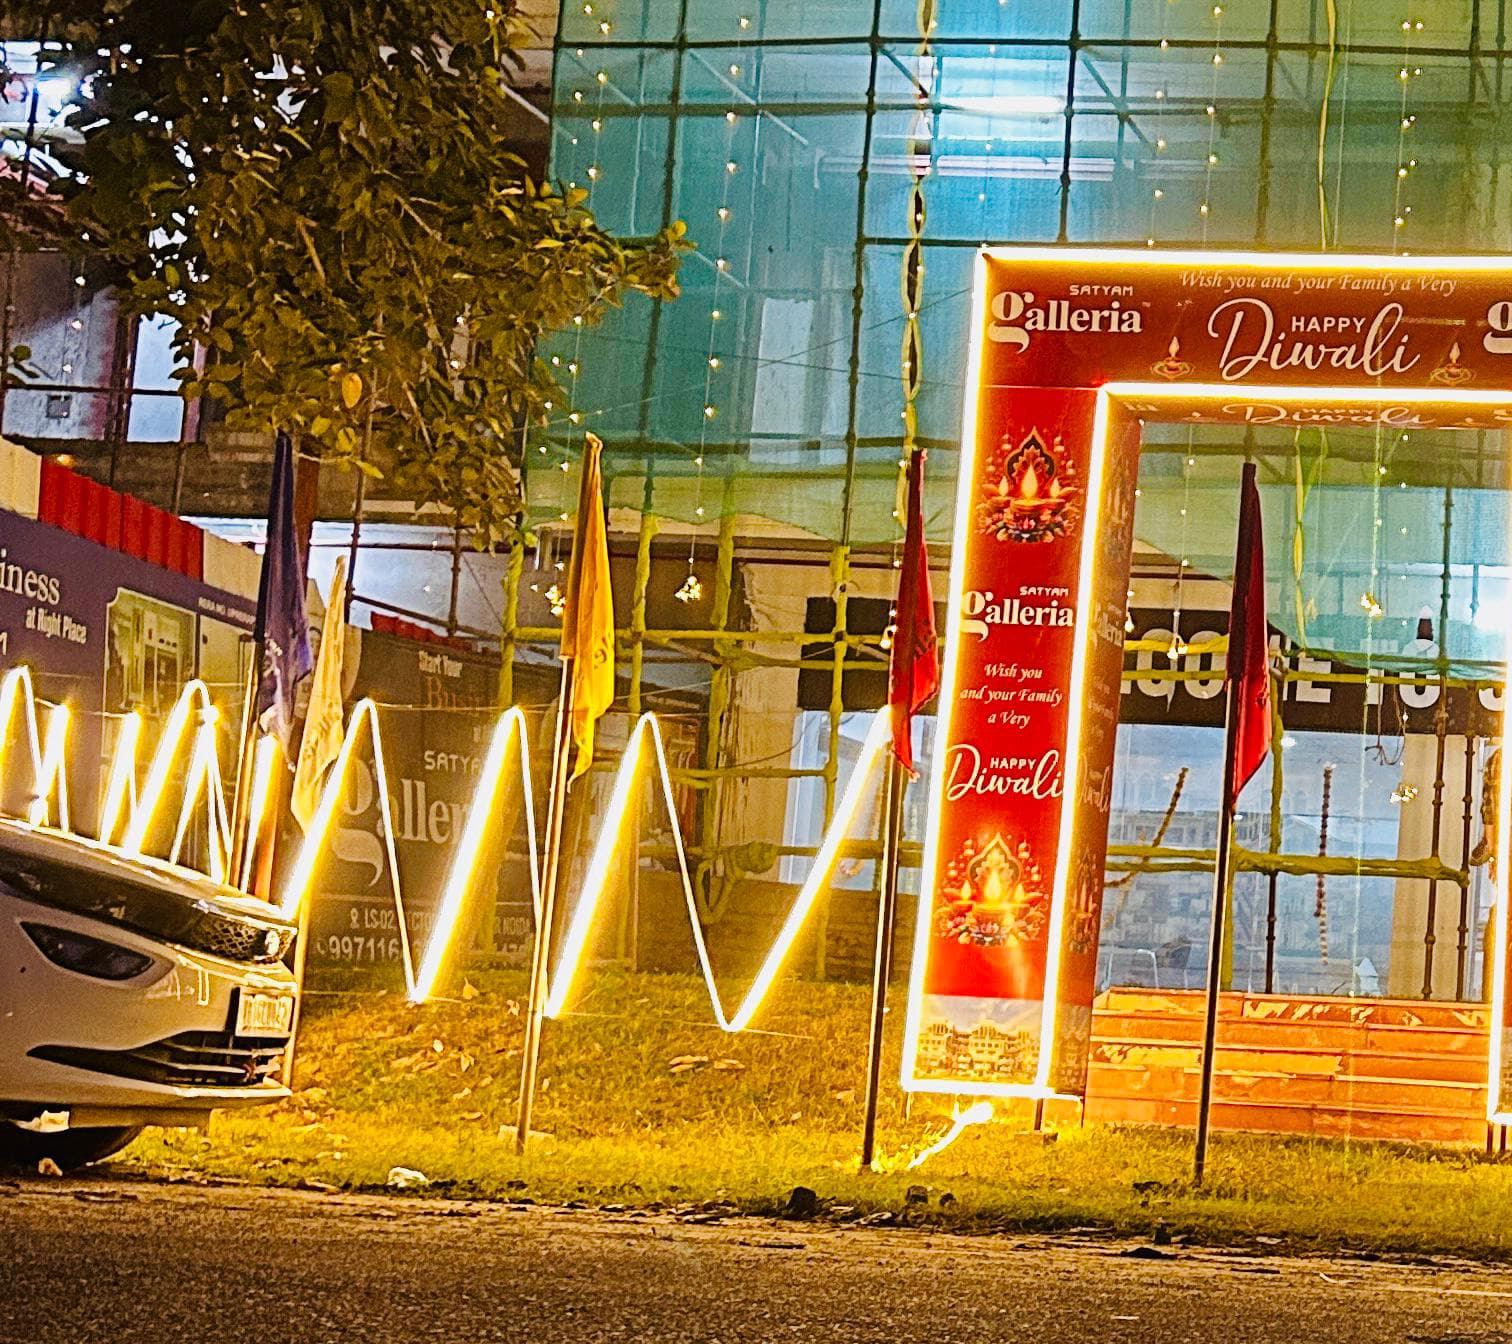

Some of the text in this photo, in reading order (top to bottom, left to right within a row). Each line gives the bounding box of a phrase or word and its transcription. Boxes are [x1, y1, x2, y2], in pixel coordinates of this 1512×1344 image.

[1069, 285, 1133, 297] SATYAM
[1179, 271, 1458, 297] Wish you and your Family a Very
[987, 291, 1143, 354] galleria
[1291, 316, 1366, 334] HAPPY
[1207, 297, 1421, 382] Diwali
[1019, 585, 1069, 597] SATYAM
[959, 591, 1074, 643] galleria
[63, 616, 87, 644] Place
[984, 663, 1043, 682] Wish you
[960, 685, 1062, 707] and your Family
[987, 709, 1030, 729] a Very
[946, 743, 1063, 801] Diwali
[990, 757, 1037, 769] HAPPY
